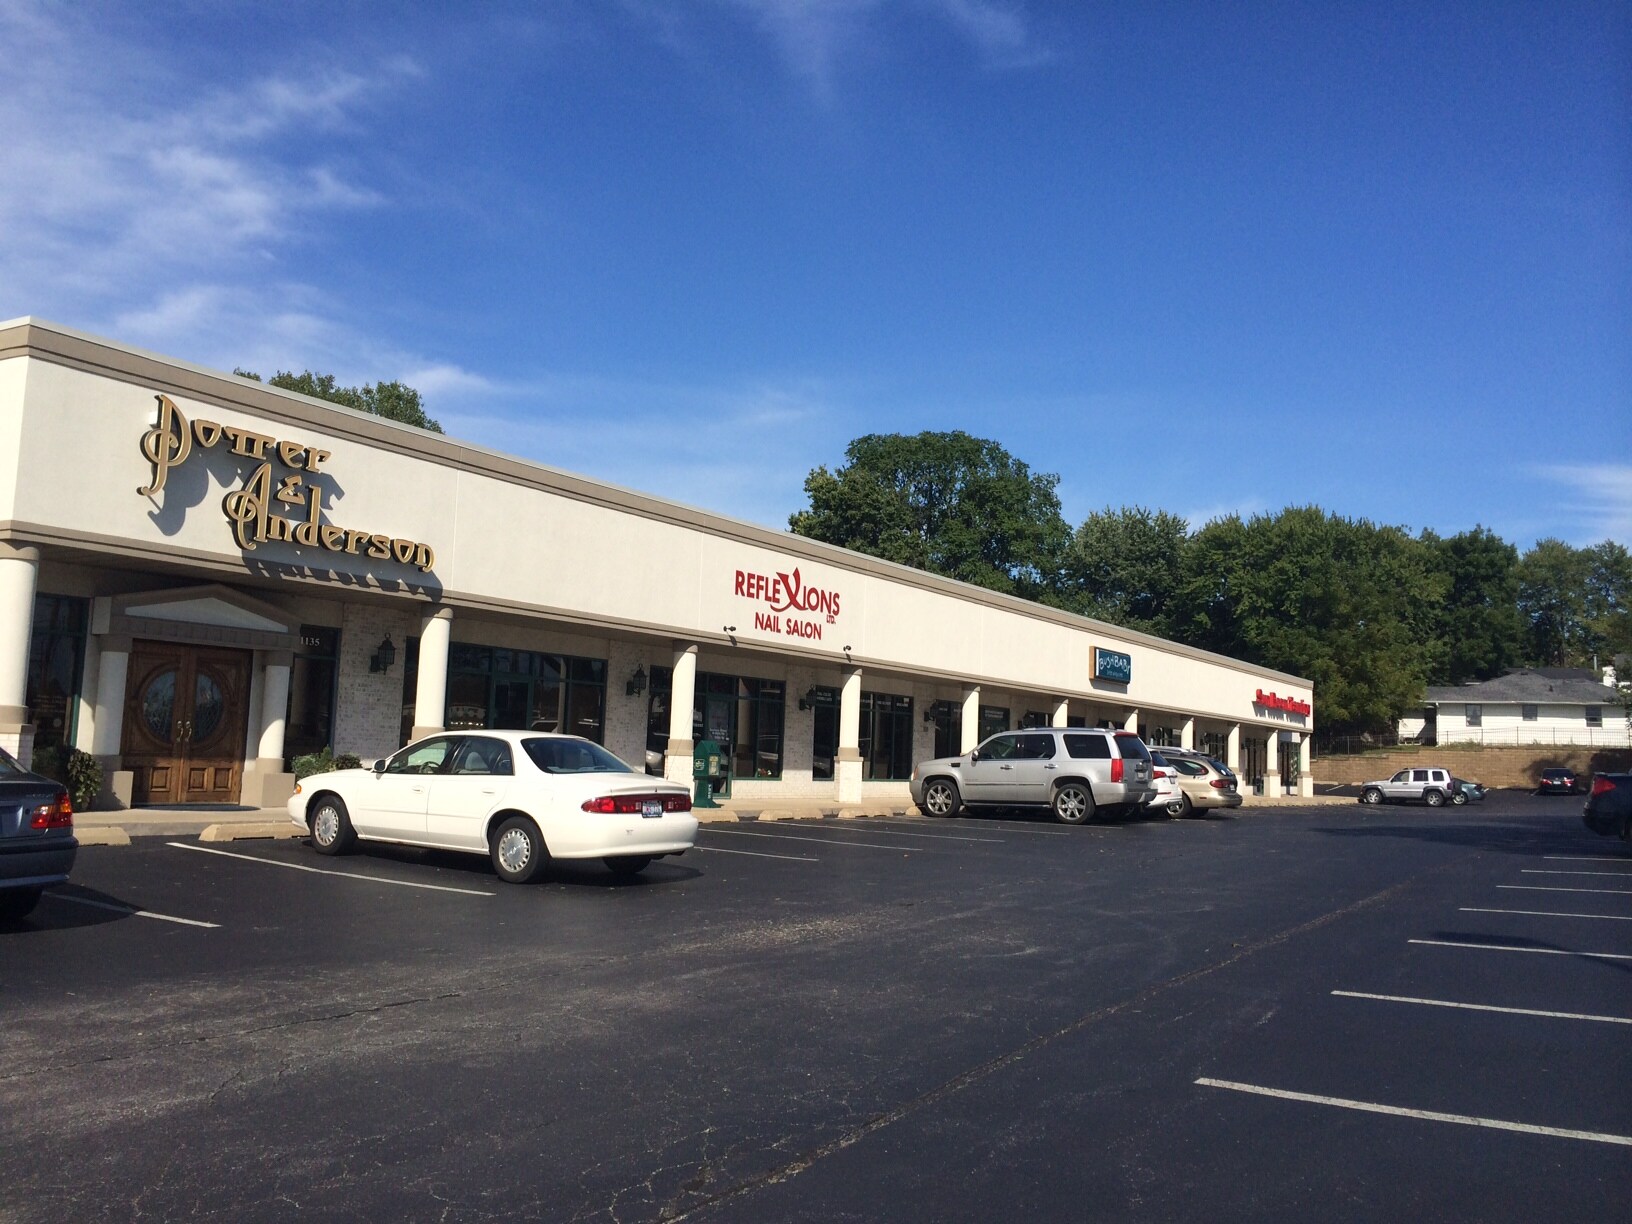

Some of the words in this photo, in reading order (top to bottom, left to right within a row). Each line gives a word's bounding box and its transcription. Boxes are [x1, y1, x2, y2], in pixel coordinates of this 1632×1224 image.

[222, 463, 435, 573] Anderson
[735, 567, 840, 616] REFLEXIONS
[300, 636, 321, 647] 1135
[755, 612, 781, 634] NAIL
[786, 618, 822, 641] SALON
